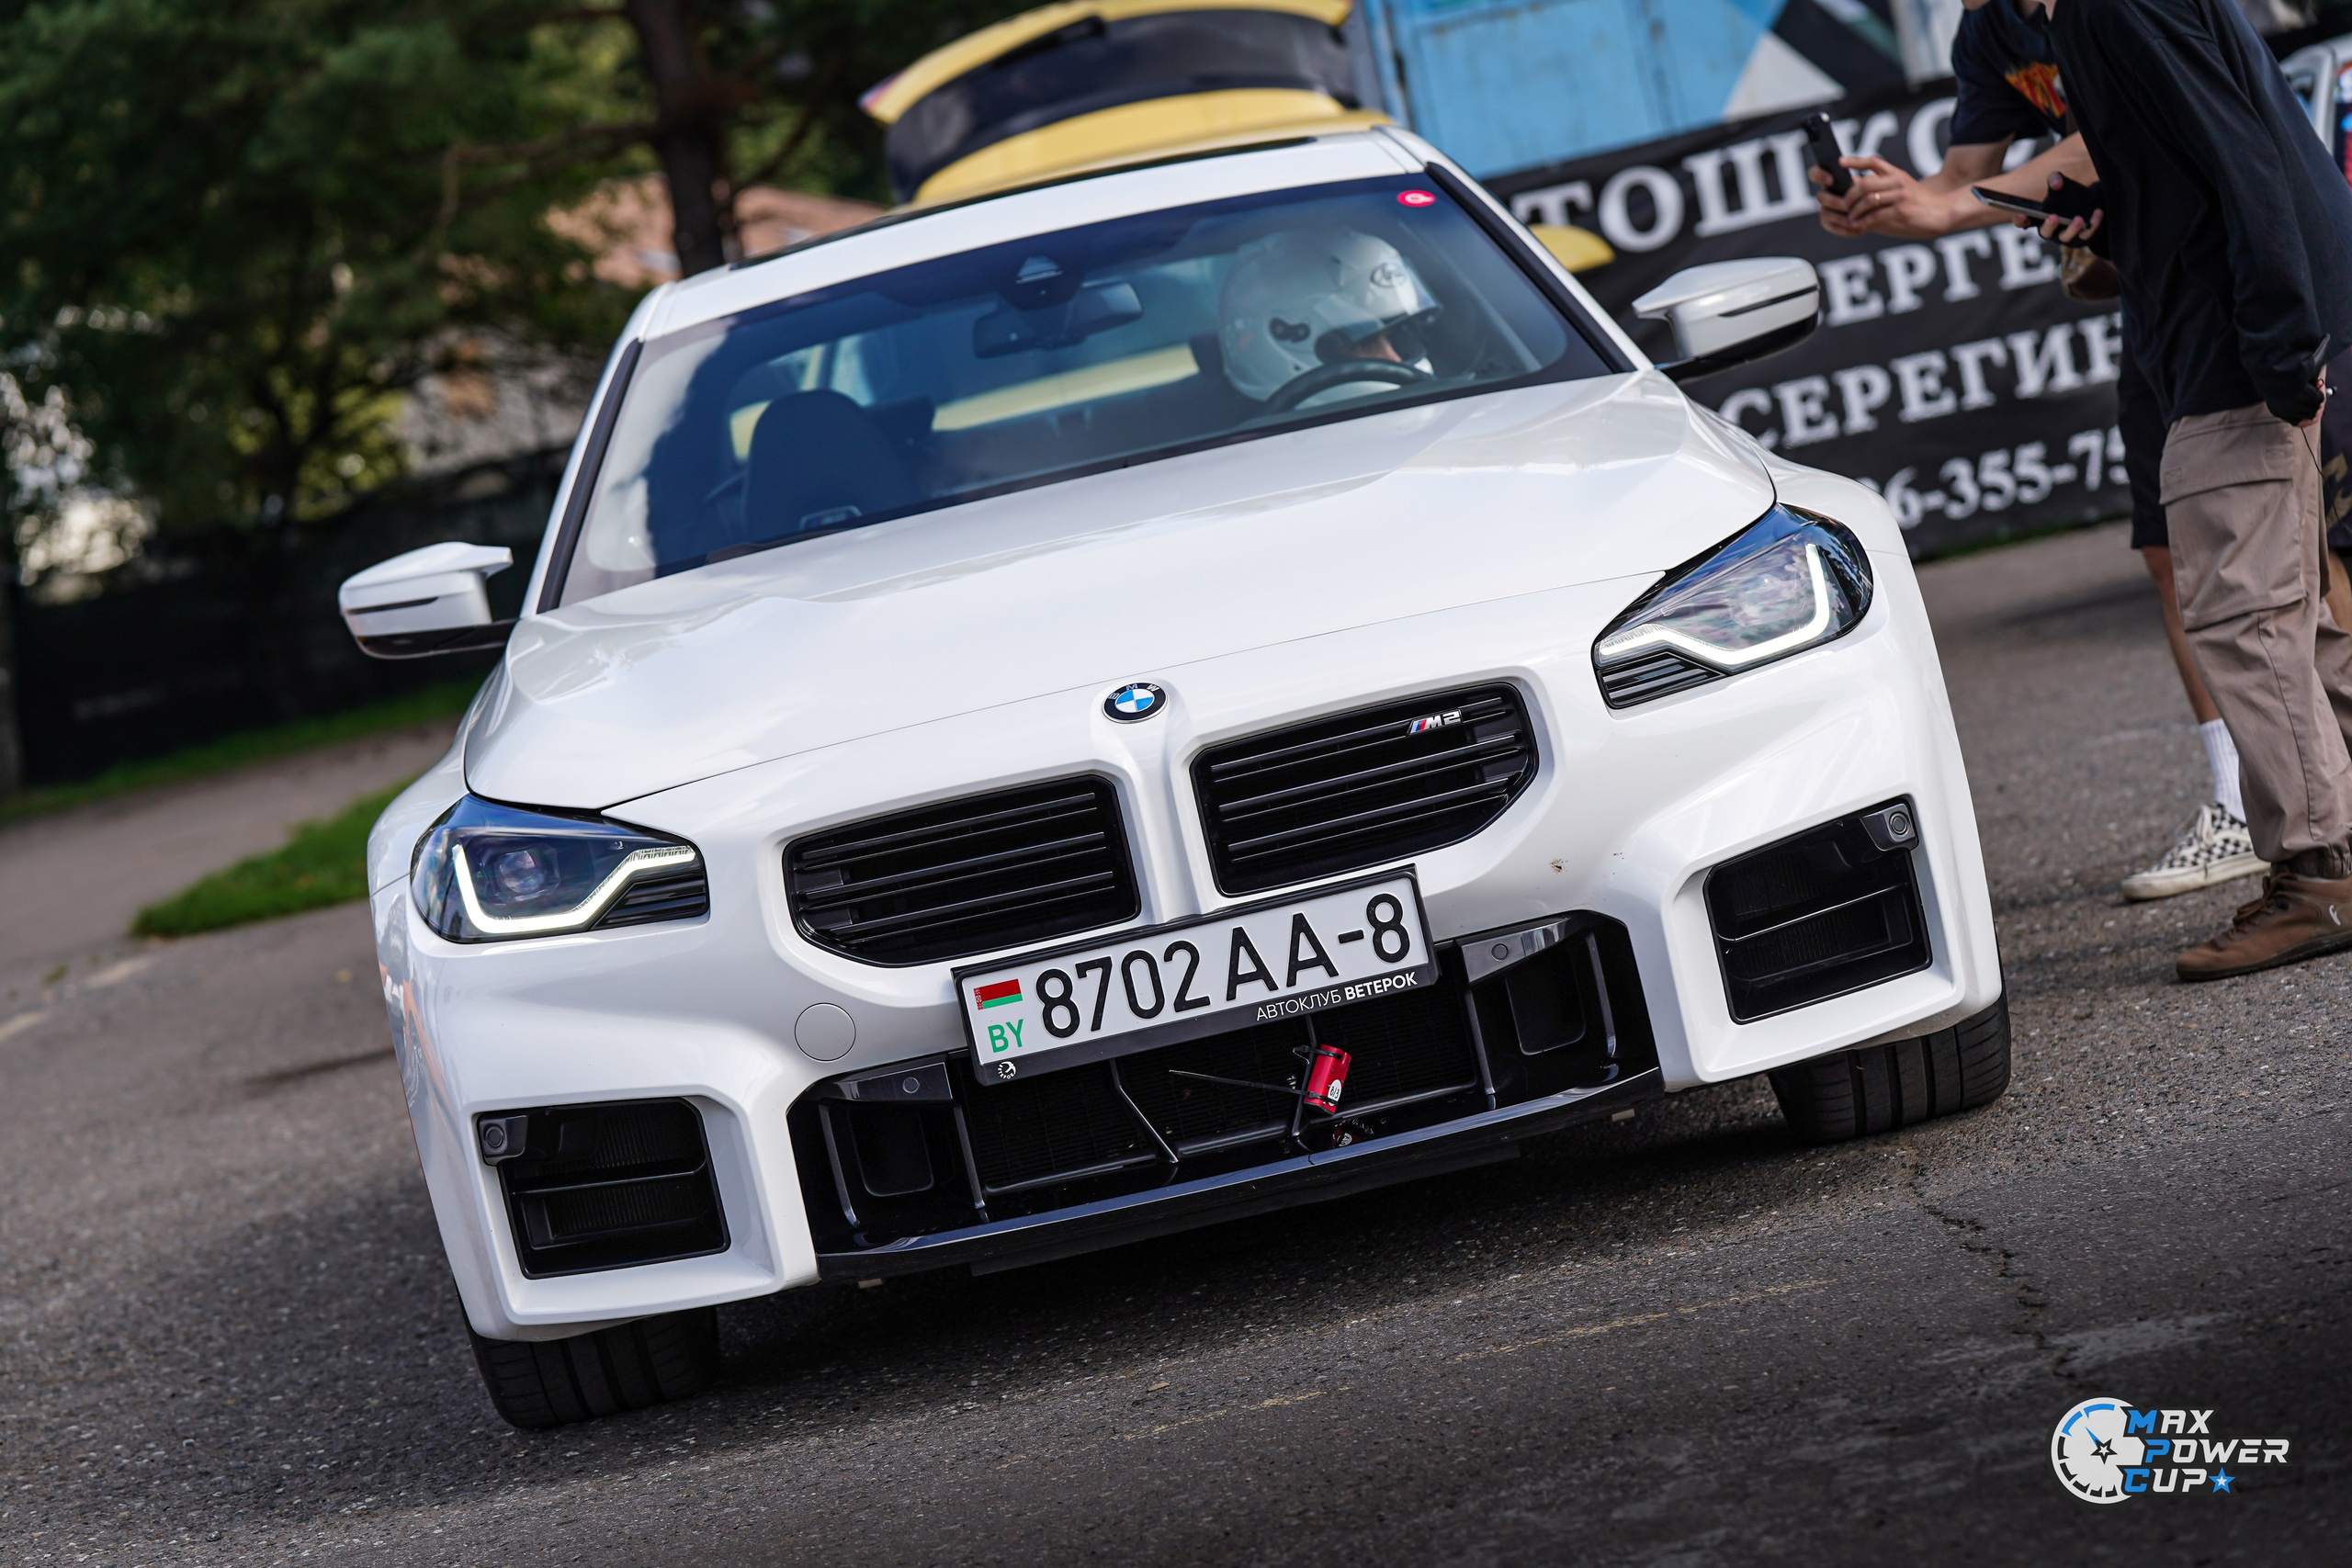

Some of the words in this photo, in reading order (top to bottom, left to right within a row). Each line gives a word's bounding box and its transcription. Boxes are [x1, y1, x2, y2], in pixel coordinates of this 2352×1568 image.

[1816, 222, 2060, 327] ЕРГЕ
[1107, 682, 1160, 700] BMW
[1424, 711, 1461, 730] M2
[1256, 989, 1341, 1021] АВТОКЛУБ
[1344, 972, 1418, 1001] ВЕТЕРОК
[988, 1019, 1023, 1053] BY
